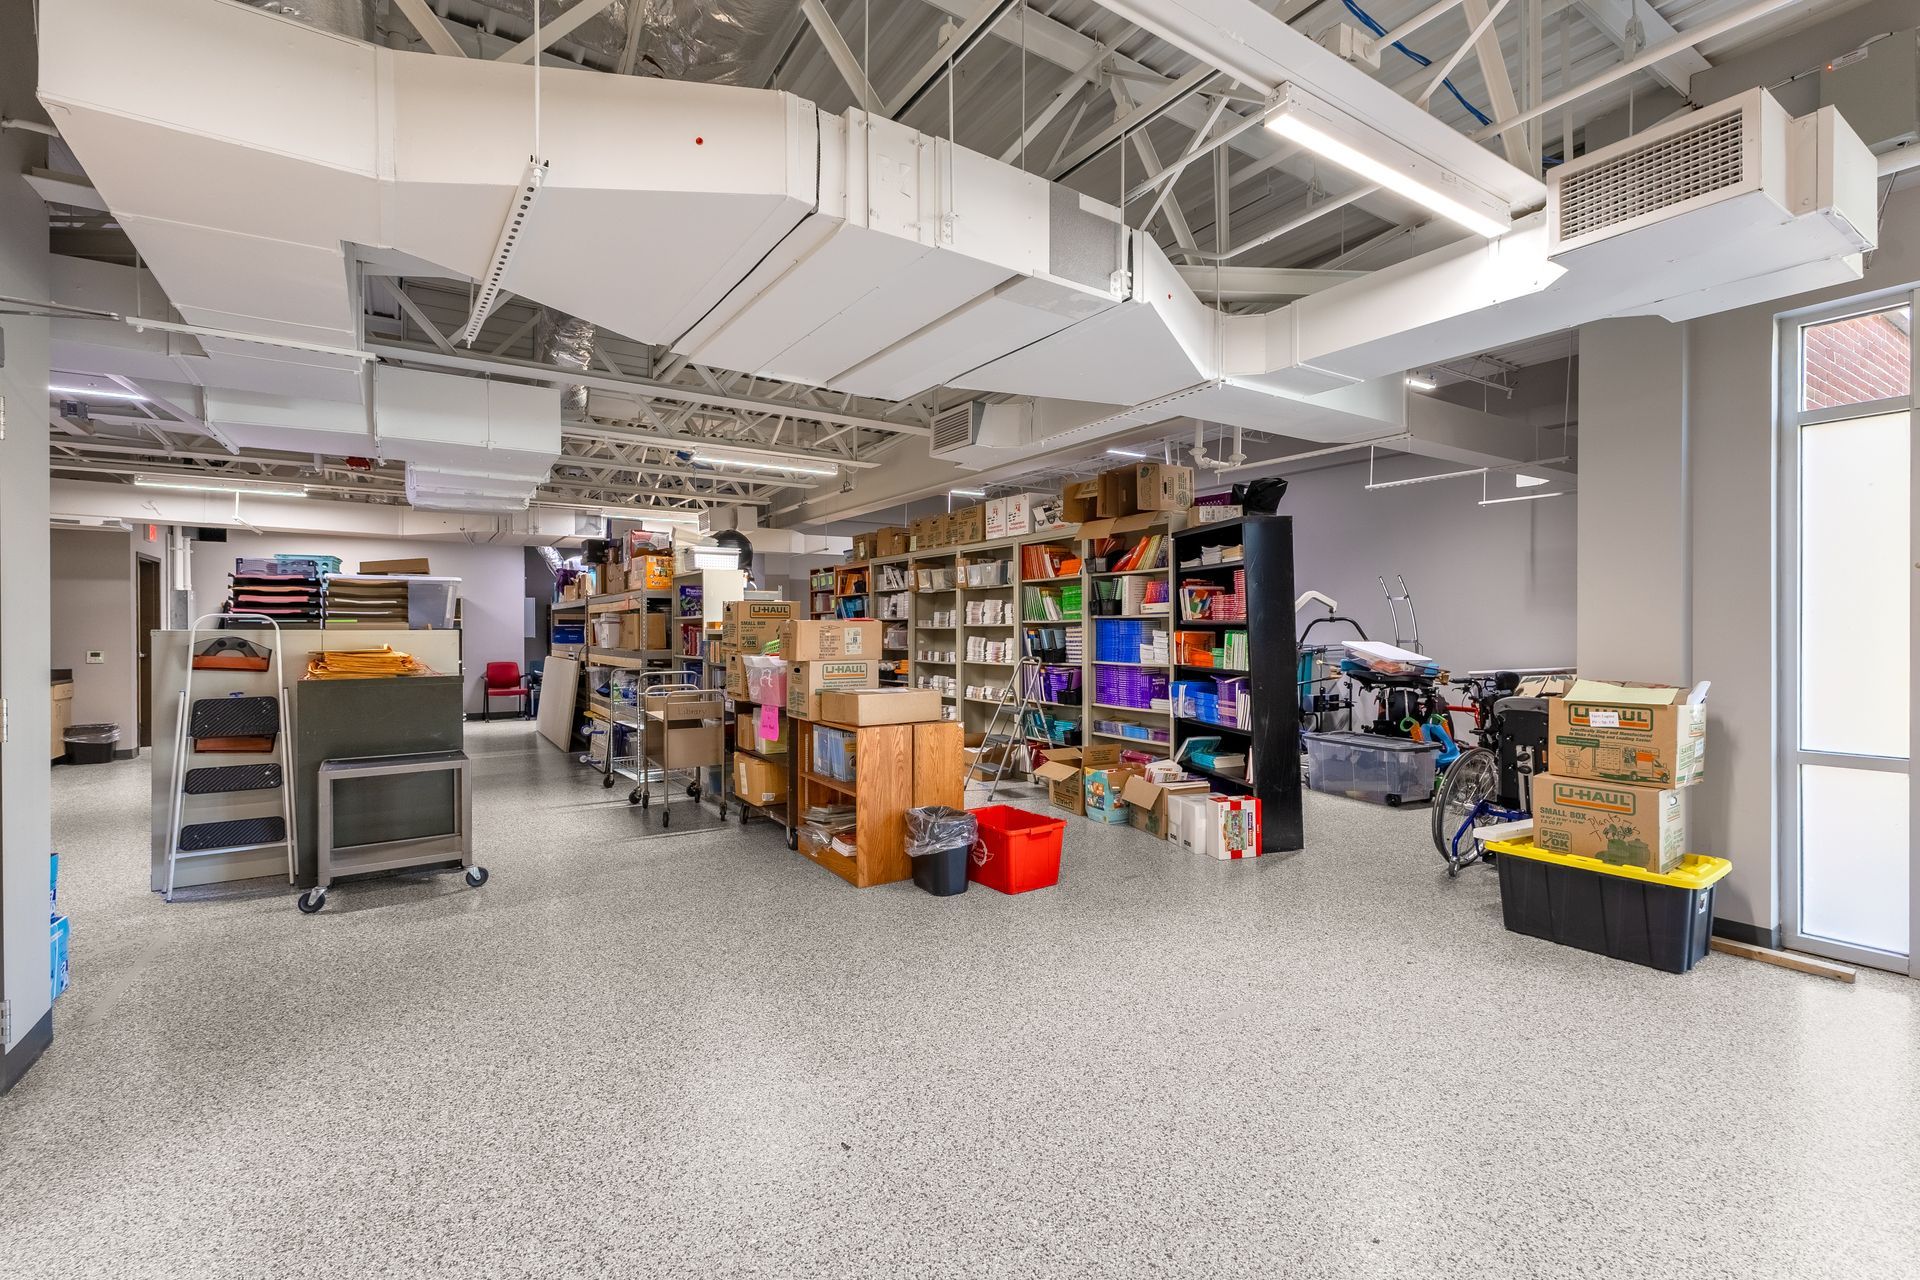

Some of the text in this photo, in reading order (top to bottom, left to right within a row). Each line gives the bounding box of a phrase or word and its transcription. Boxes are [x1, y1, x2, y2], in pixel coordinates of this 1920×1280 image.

[825, 665, 865, 673] U-HAUL
[1558, 786, 1630, 806] U-HAUL
[1540, 806, 1587, 821] SMALL BOX
[1551, 838, 1569, 848] OK
